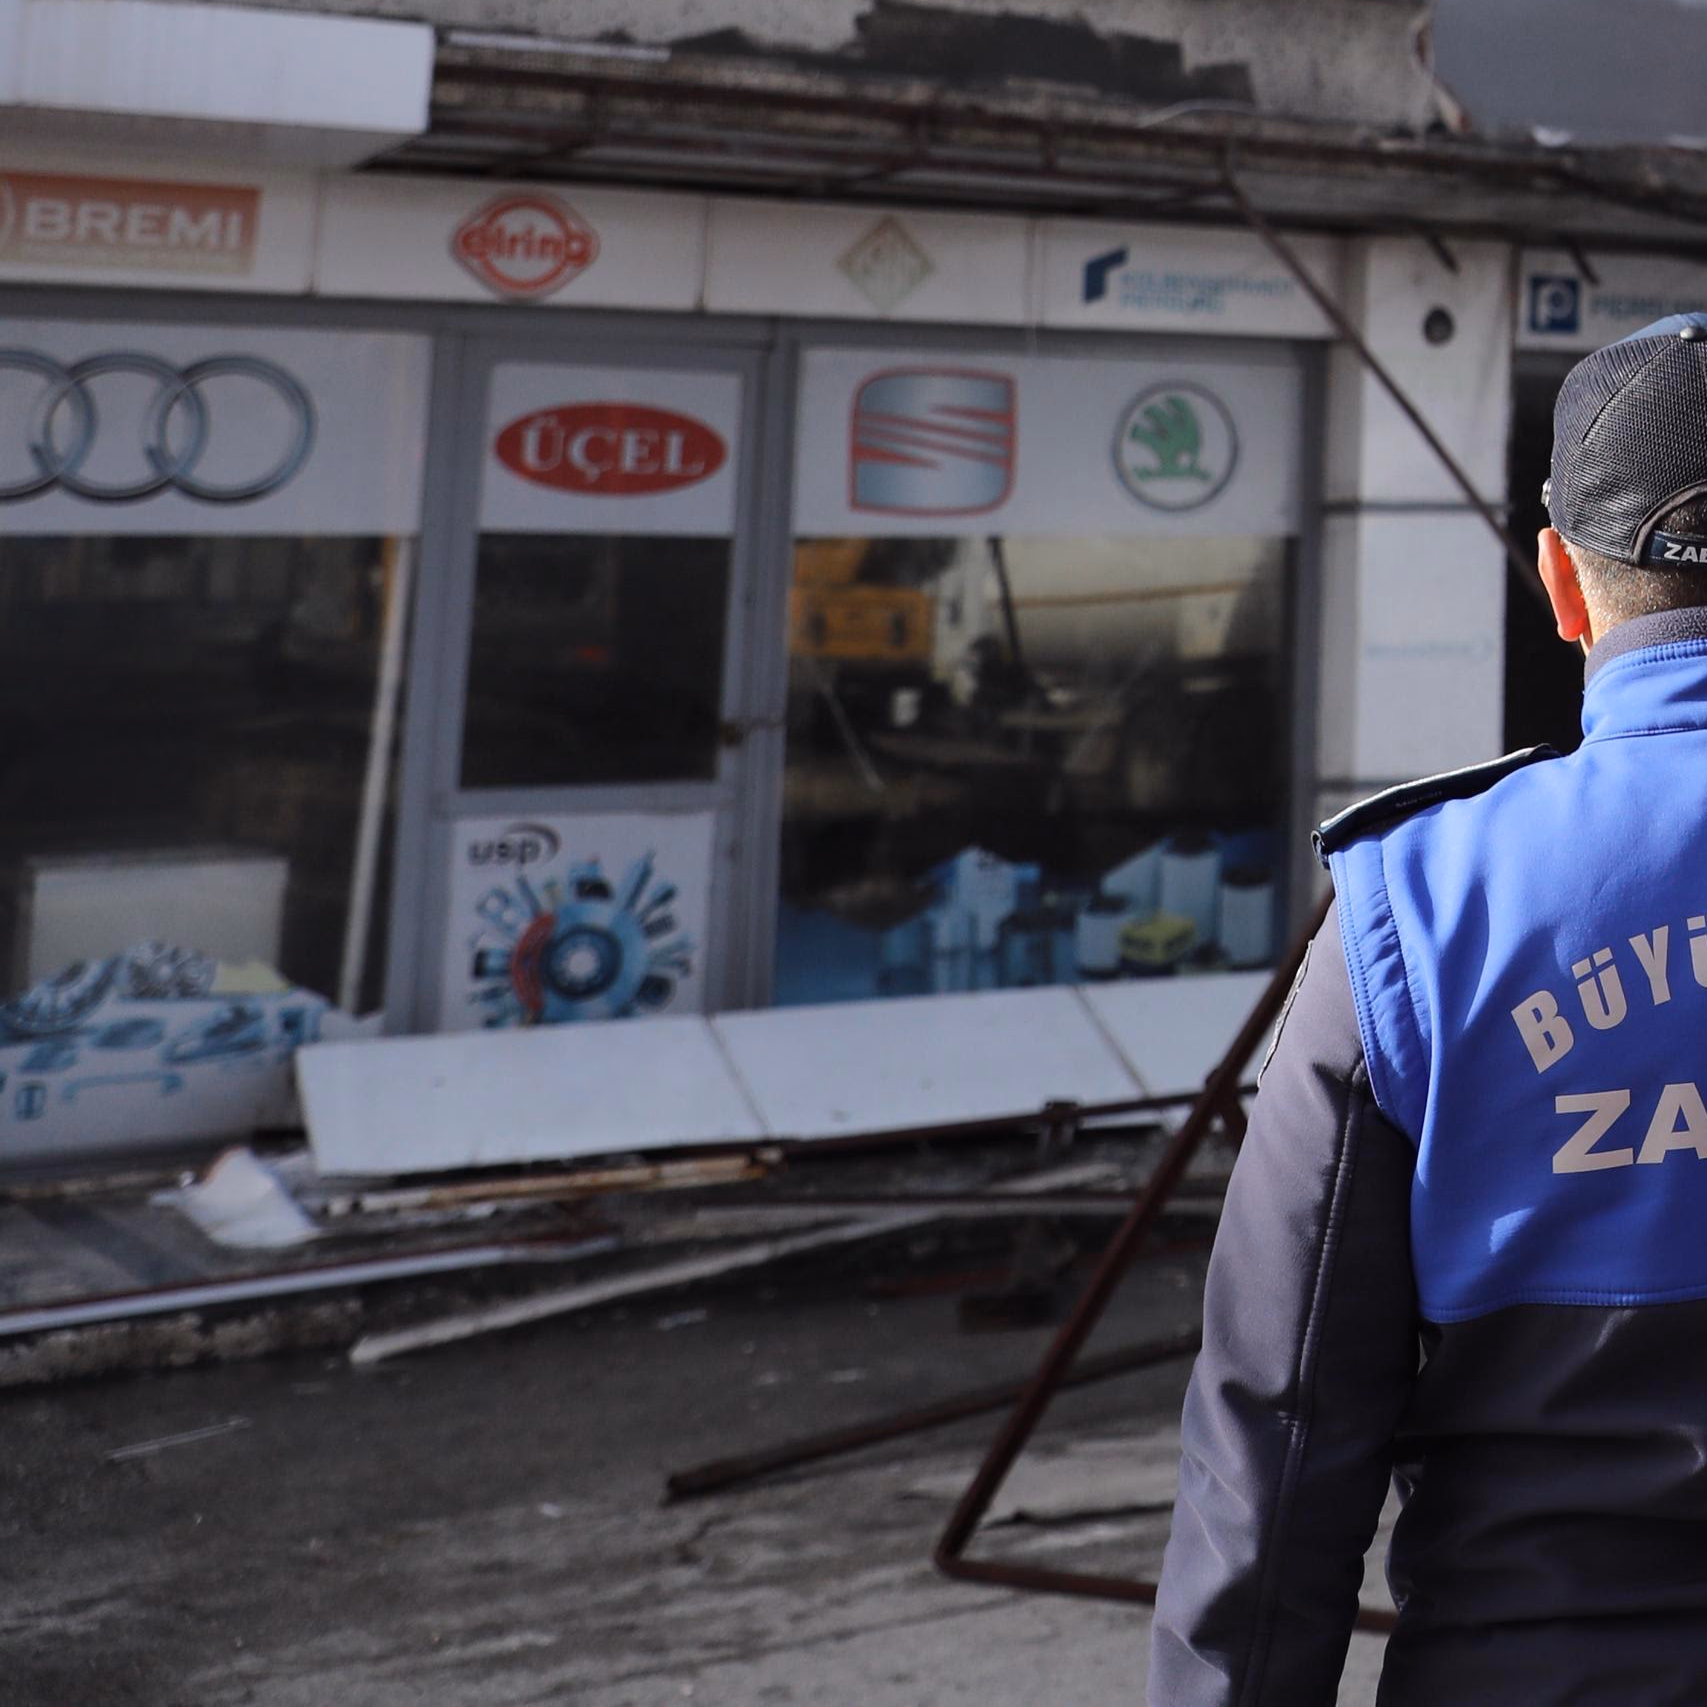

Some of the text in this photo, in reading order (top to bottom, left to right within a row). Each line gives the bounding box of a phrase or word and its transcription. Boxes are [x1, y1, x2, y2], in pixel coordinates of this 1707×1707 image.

[24, 196, 244, 251] BREMI
[460, 221, 594, 268] elring
[519, 422, 706, 482] ÜÇEL
[468, 838, 543, 870] usp
